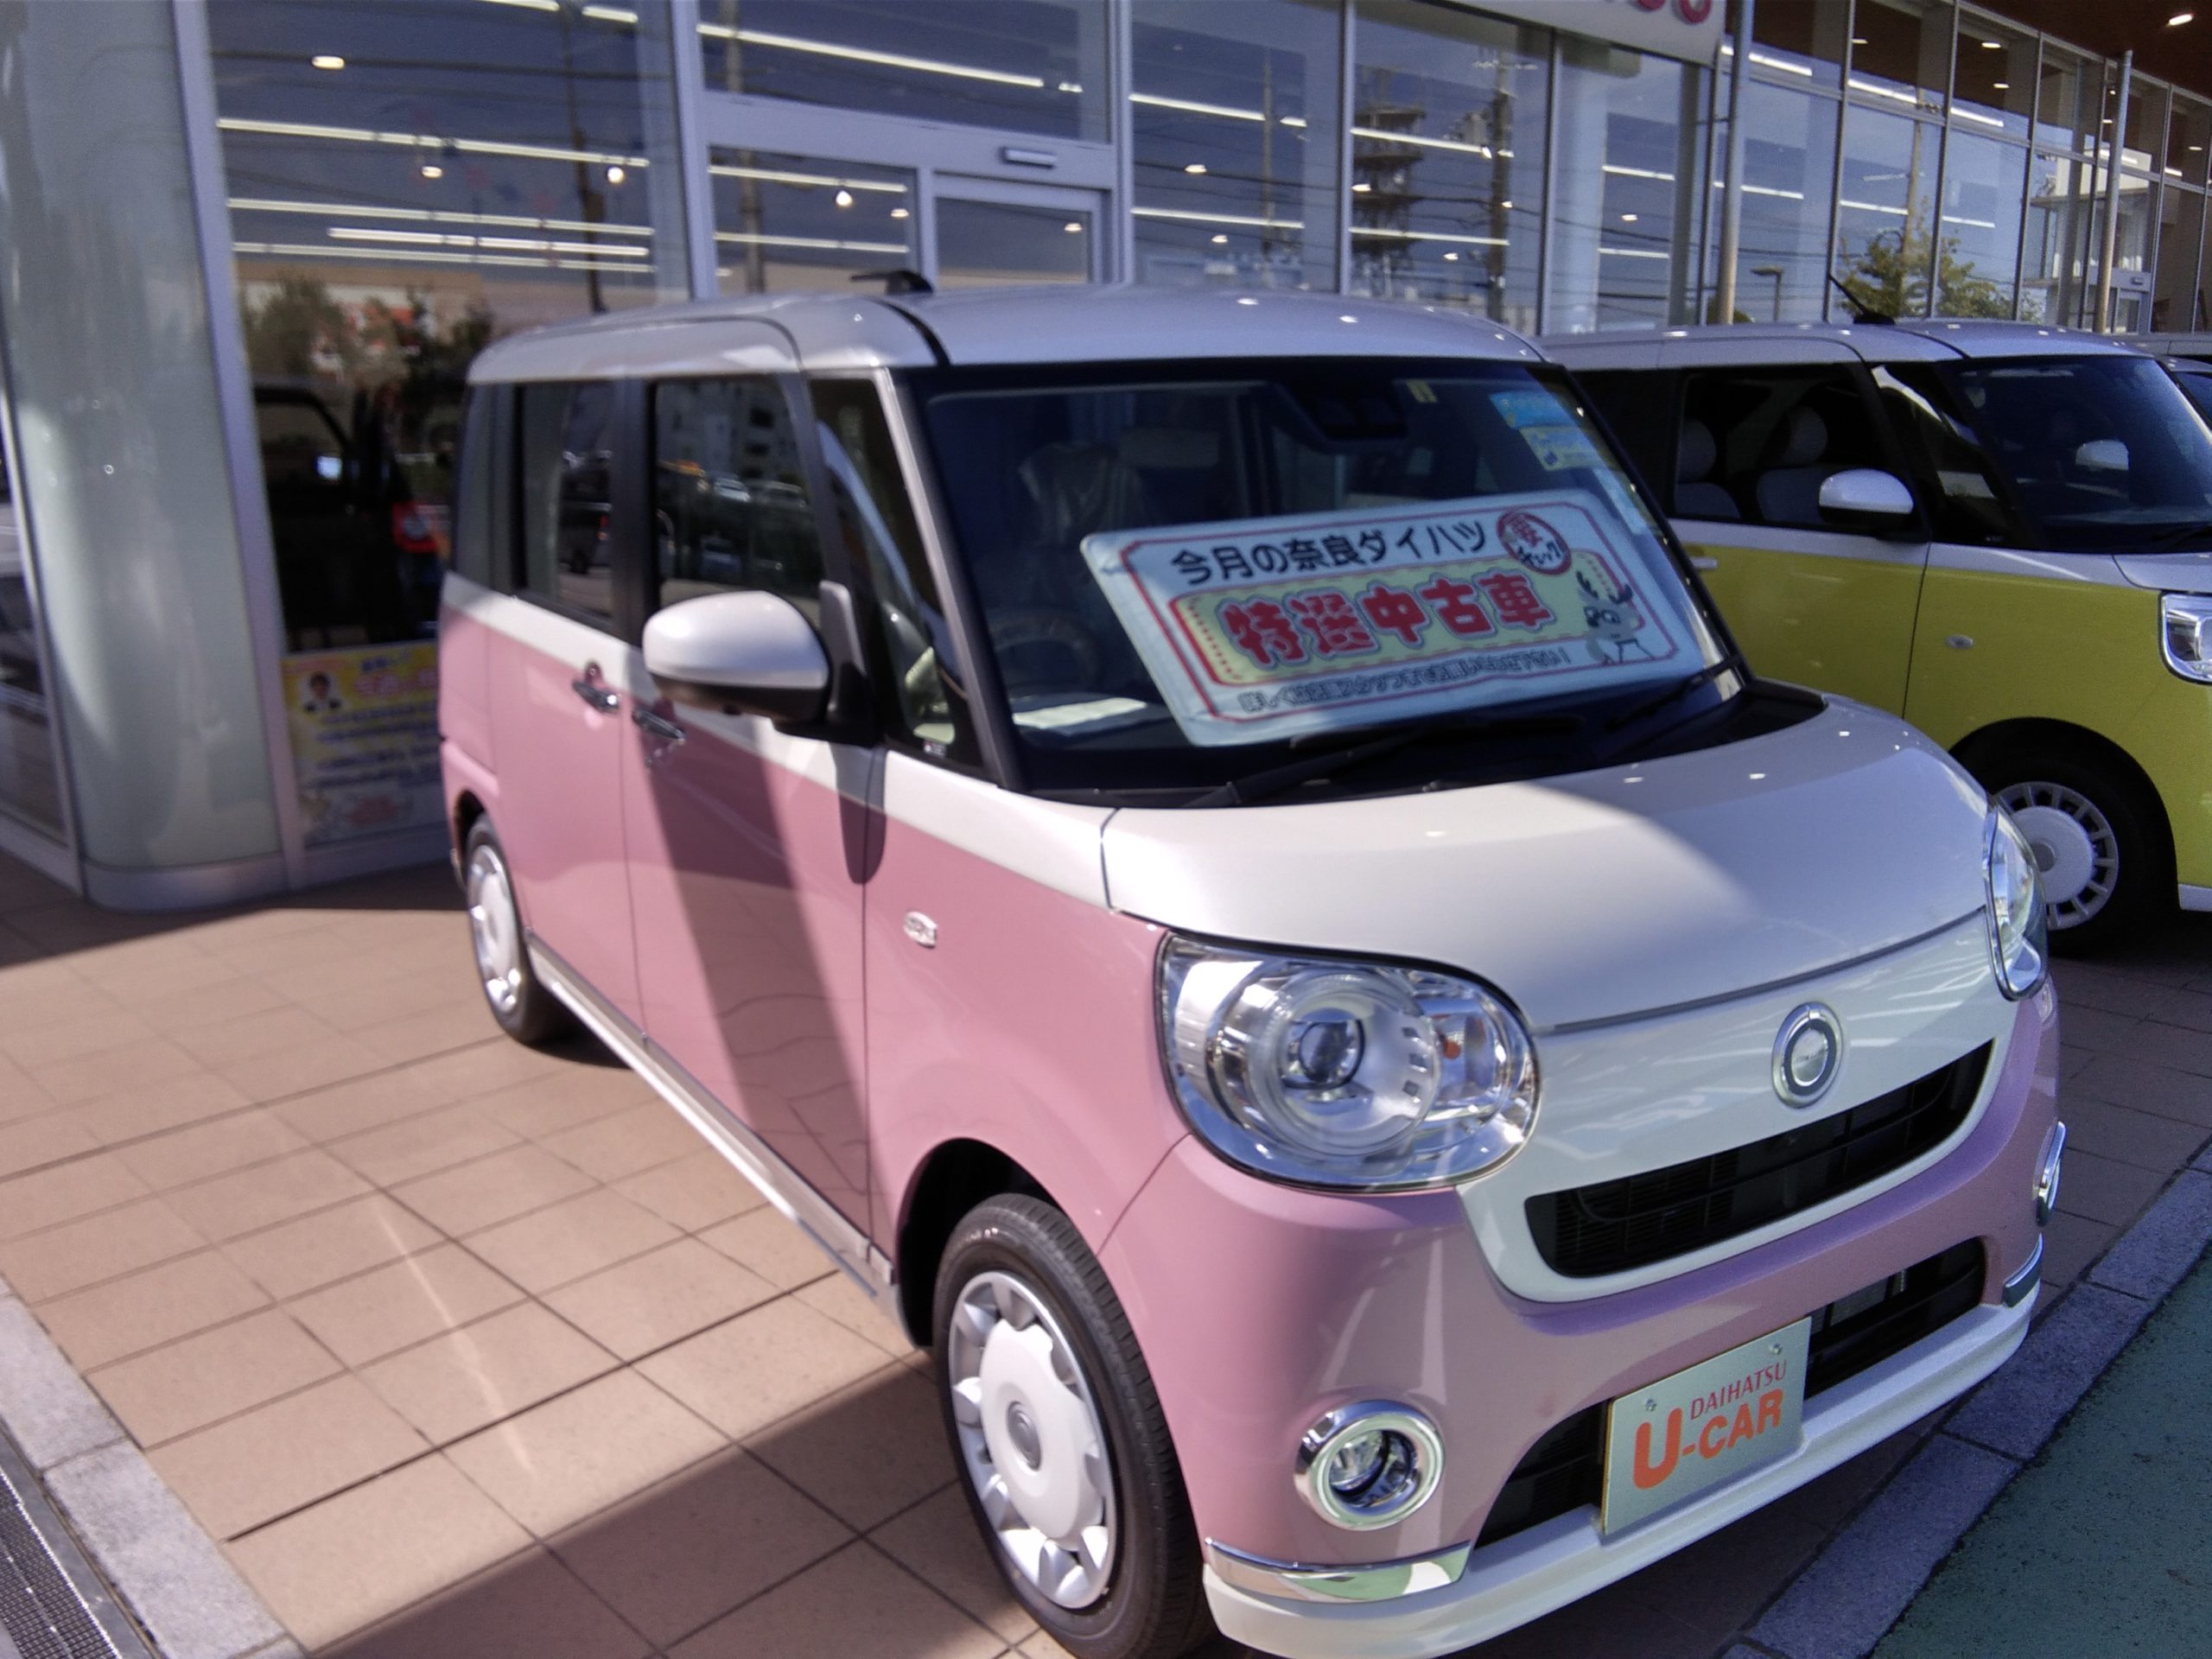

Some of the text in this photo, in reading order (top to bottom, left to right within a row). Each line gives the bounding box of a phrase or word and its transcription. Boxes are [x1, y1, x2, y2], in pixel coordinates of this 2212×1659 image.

[1172, 522, 1486, 585] 今月の奈良ダイハツ
[1219, 571, 1554, 666] 特選中古車
[1689, 1360, 1788, 1421] DAIHATSU
[1632, 1388, 1784, 1491] U-CAR
